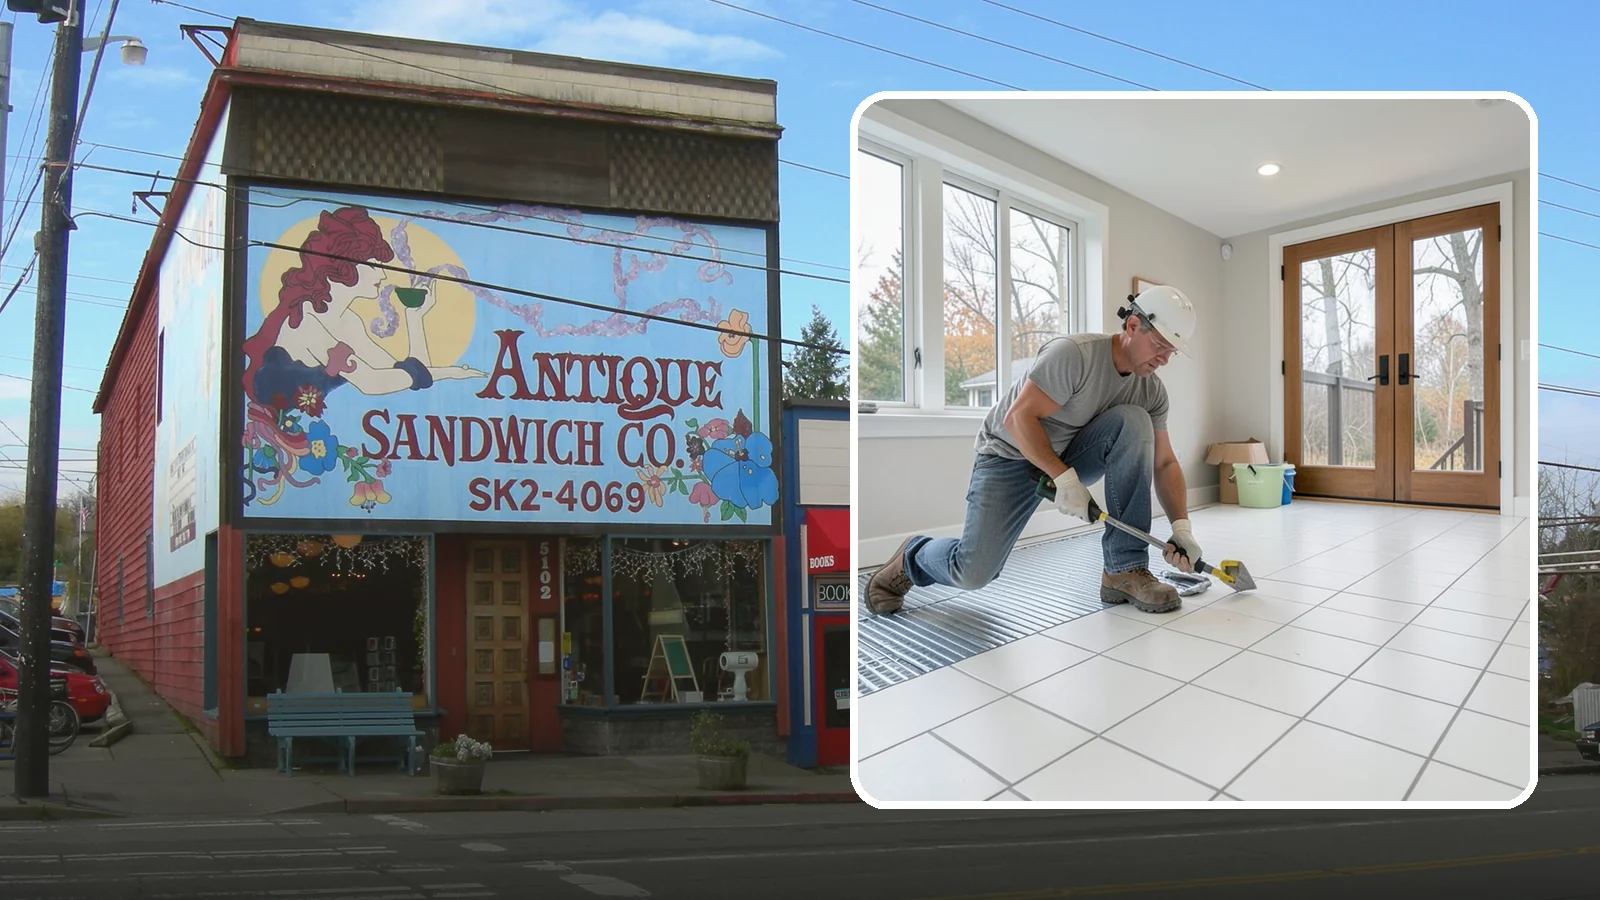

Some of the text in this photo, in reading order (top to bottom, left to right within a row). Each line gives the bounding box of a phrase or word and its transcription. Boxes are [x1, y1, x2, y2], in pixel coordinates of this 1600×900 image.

[475, 329, 724, 421] ANTIQUE
[361, 408, 685, 468] SANDWICH CO.
[468, 477, 646, 513] SK2-4069
[540, 541, 551, 600] 5102
[809, 555, 835, 569] BOOKS
